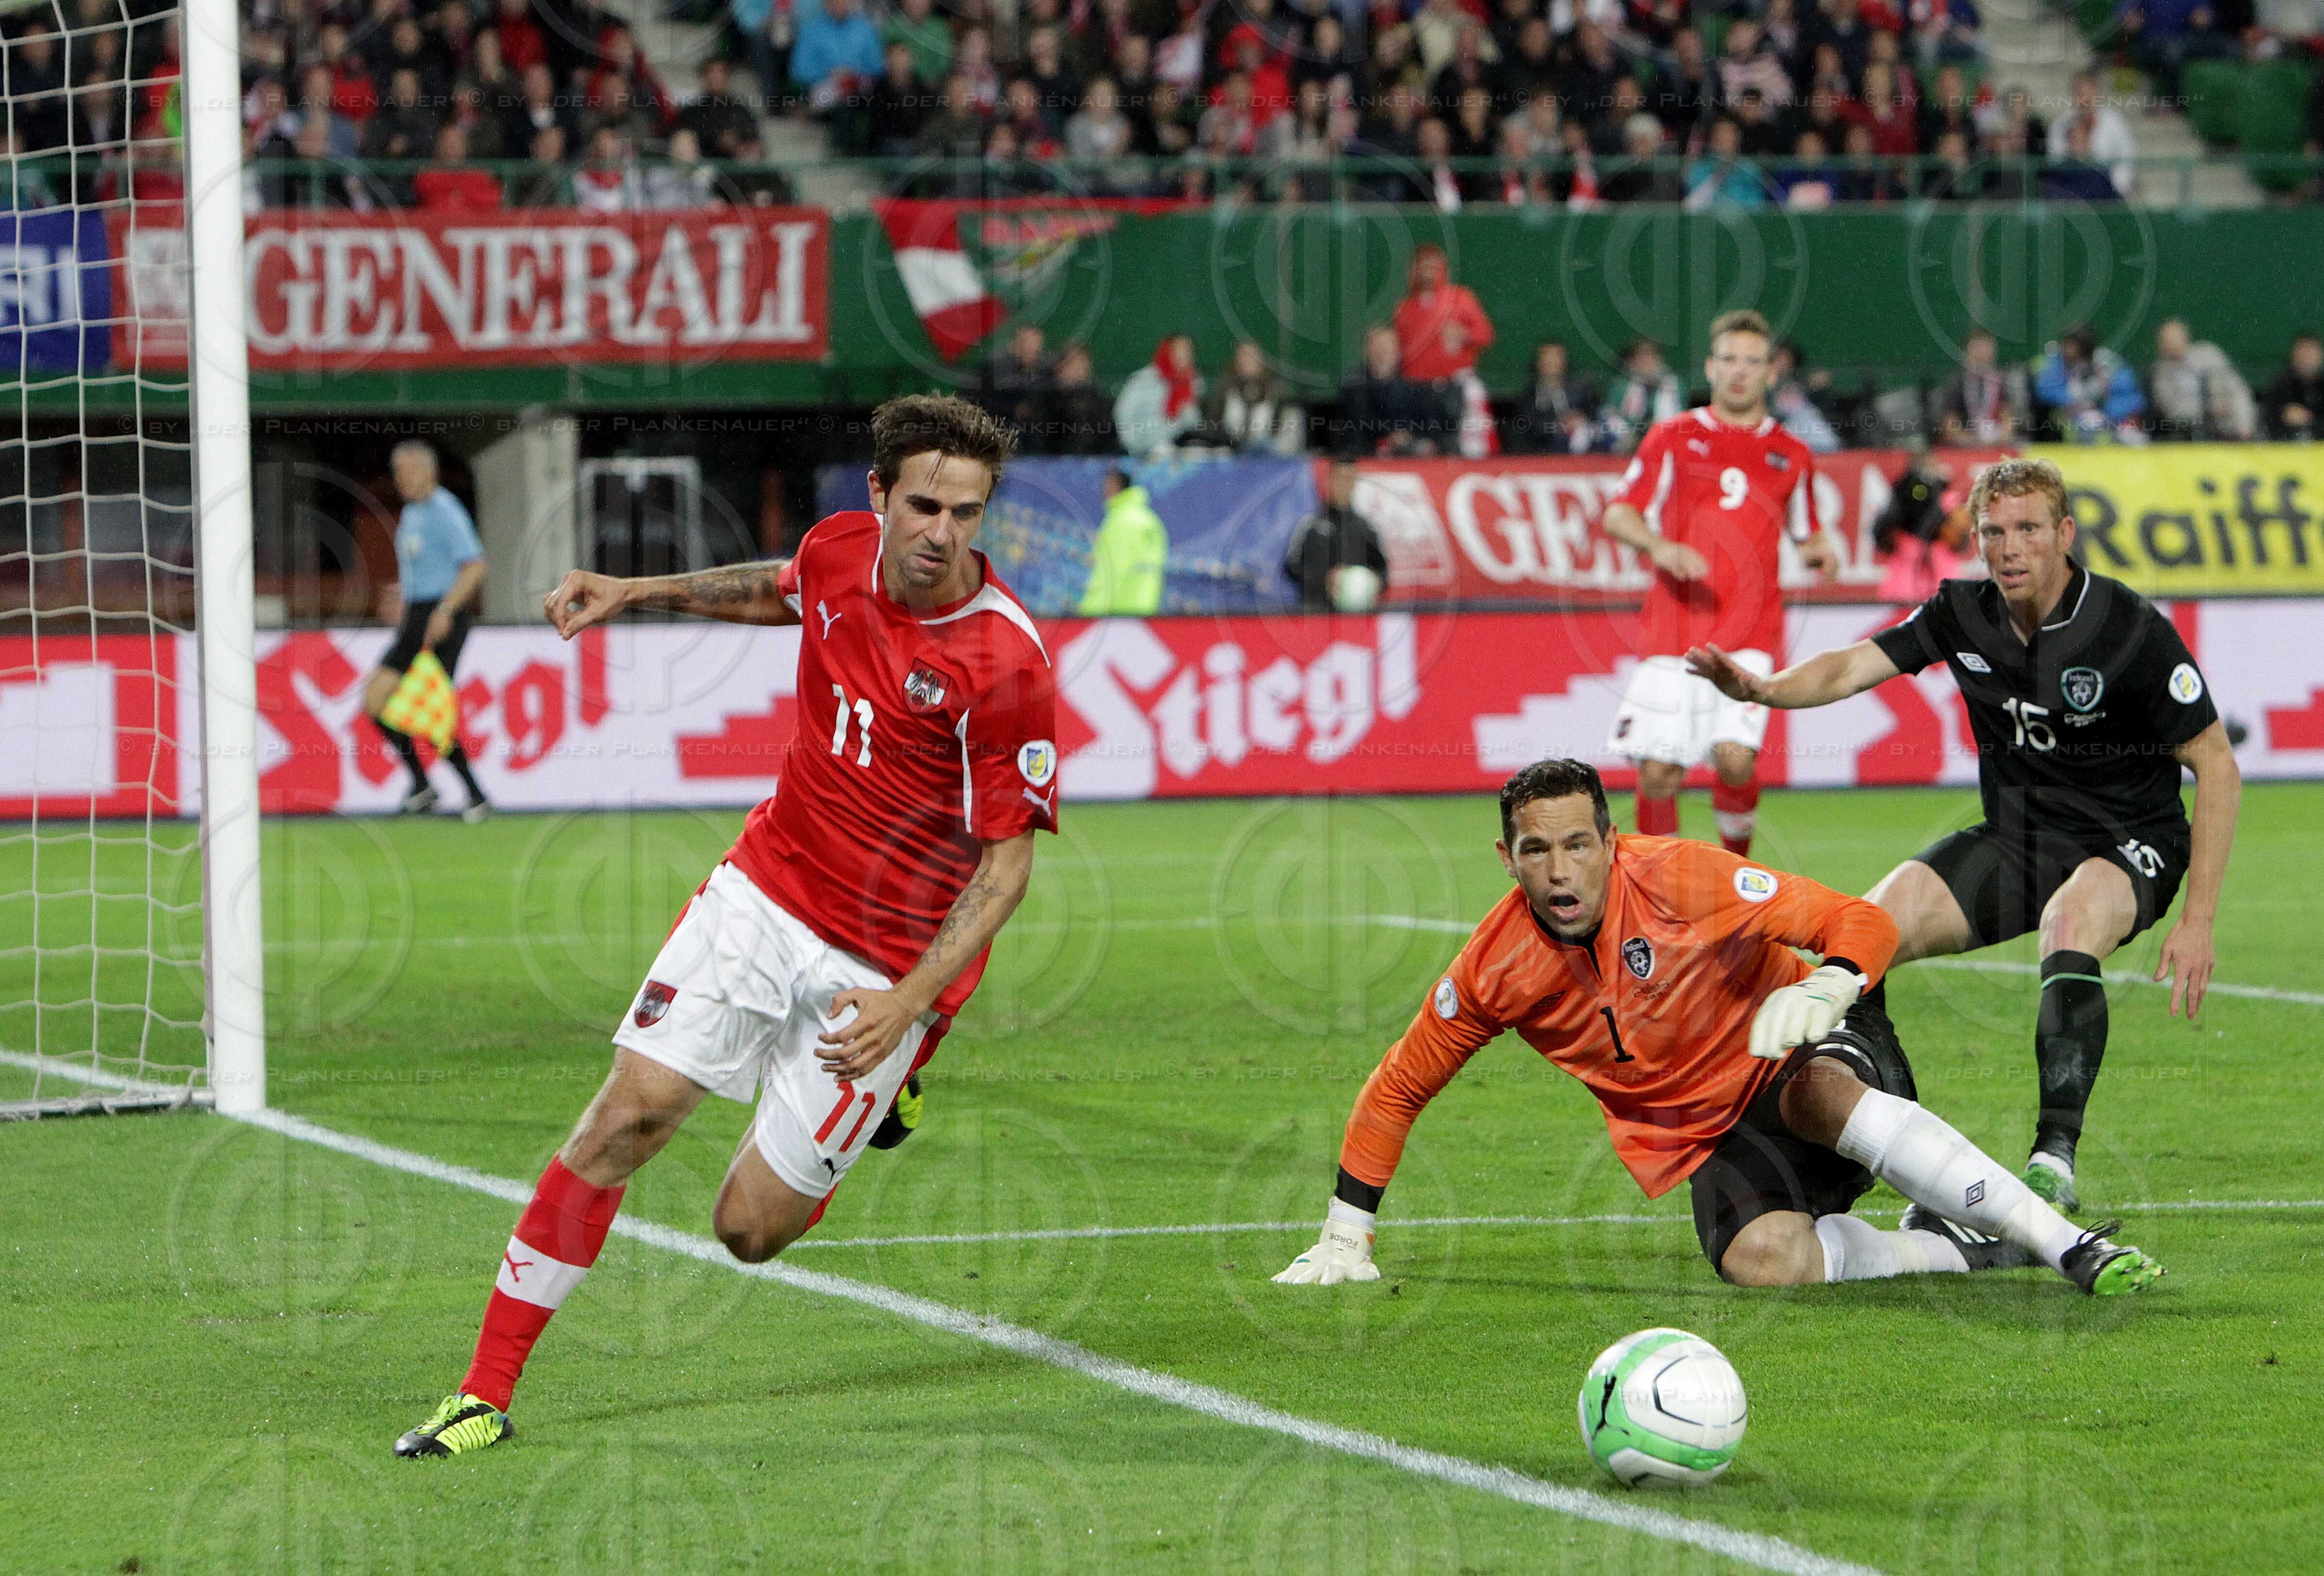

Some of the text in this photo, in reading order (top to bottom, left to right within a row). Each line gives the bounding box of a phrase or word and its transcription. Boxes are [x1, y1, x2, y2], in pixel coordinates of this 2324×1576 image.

[245, 220, 819, 354] GENERALI
[1719, 466, 1748, 510] 9
[2067, 473, 2324, 567] Raiff
[831, 683, 874, 768] 11
[1057, 613, 1422, 800] Stiegl
[2002, 697, 2056, 751] 15
[1600, 1006, 1636, 1063] 1
[813, 1080, 876, 1153] 11
[1328, 1233, 1358, 1246] FORDE
